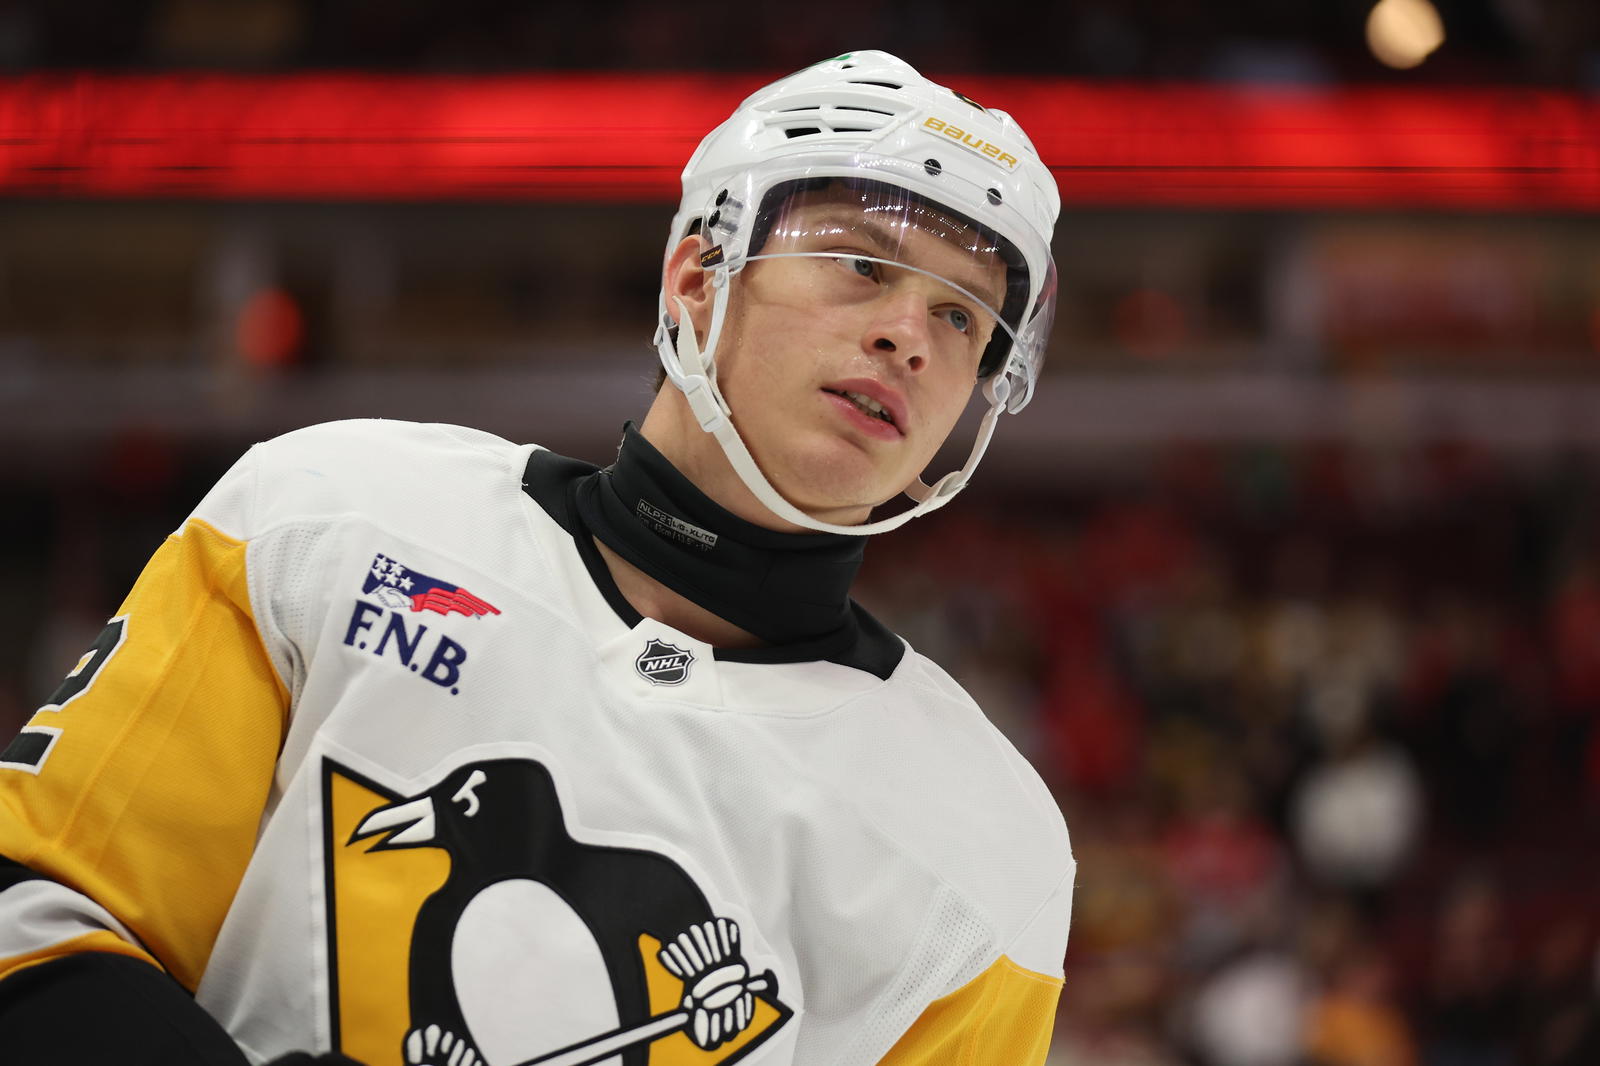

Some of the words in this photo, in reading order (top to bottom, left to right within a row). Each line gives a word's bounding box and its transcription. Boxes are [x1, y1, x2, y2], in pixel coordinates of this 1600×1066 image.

[701, 248, 721, 262] CCM
[343, 599, 467, 695] F.N.B.
[645, 657, 683, 672] NHL
